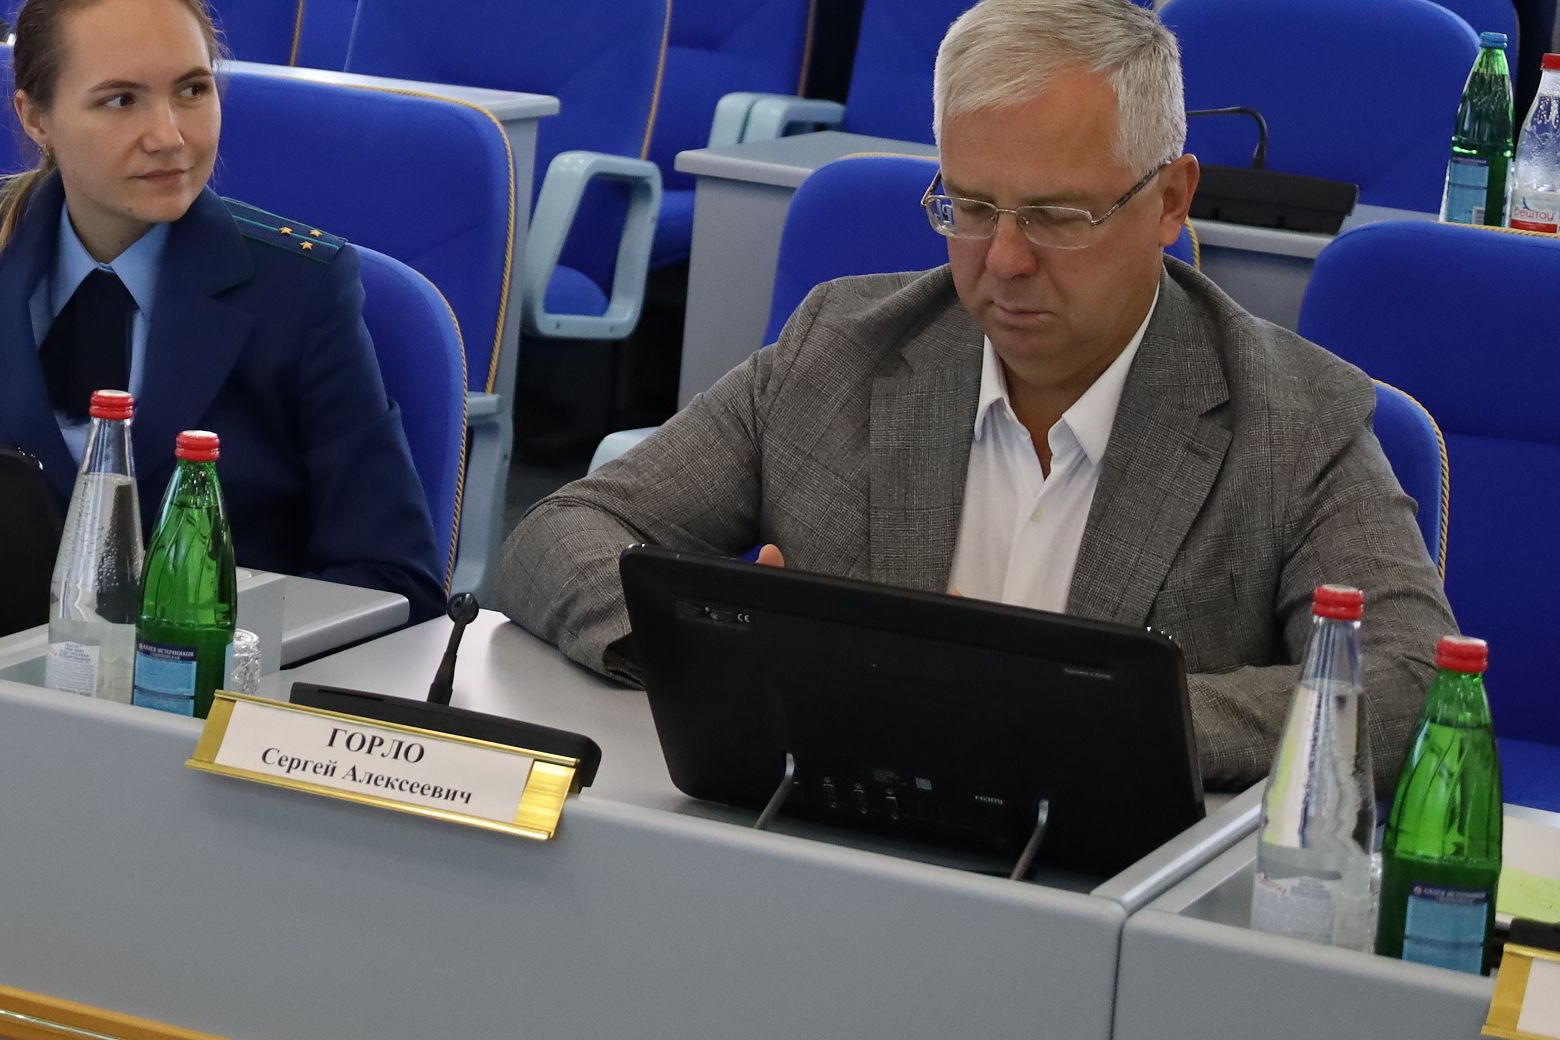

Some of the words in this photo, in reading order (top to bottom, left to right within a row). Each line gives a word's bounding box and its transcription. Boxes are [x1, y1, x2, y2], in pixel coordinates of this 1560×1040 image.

[327, 727, 425, 764] ГОРЛО
[261, 747, 336, 778] Сергей
[342, 769, 472, 805] Алексеевич
